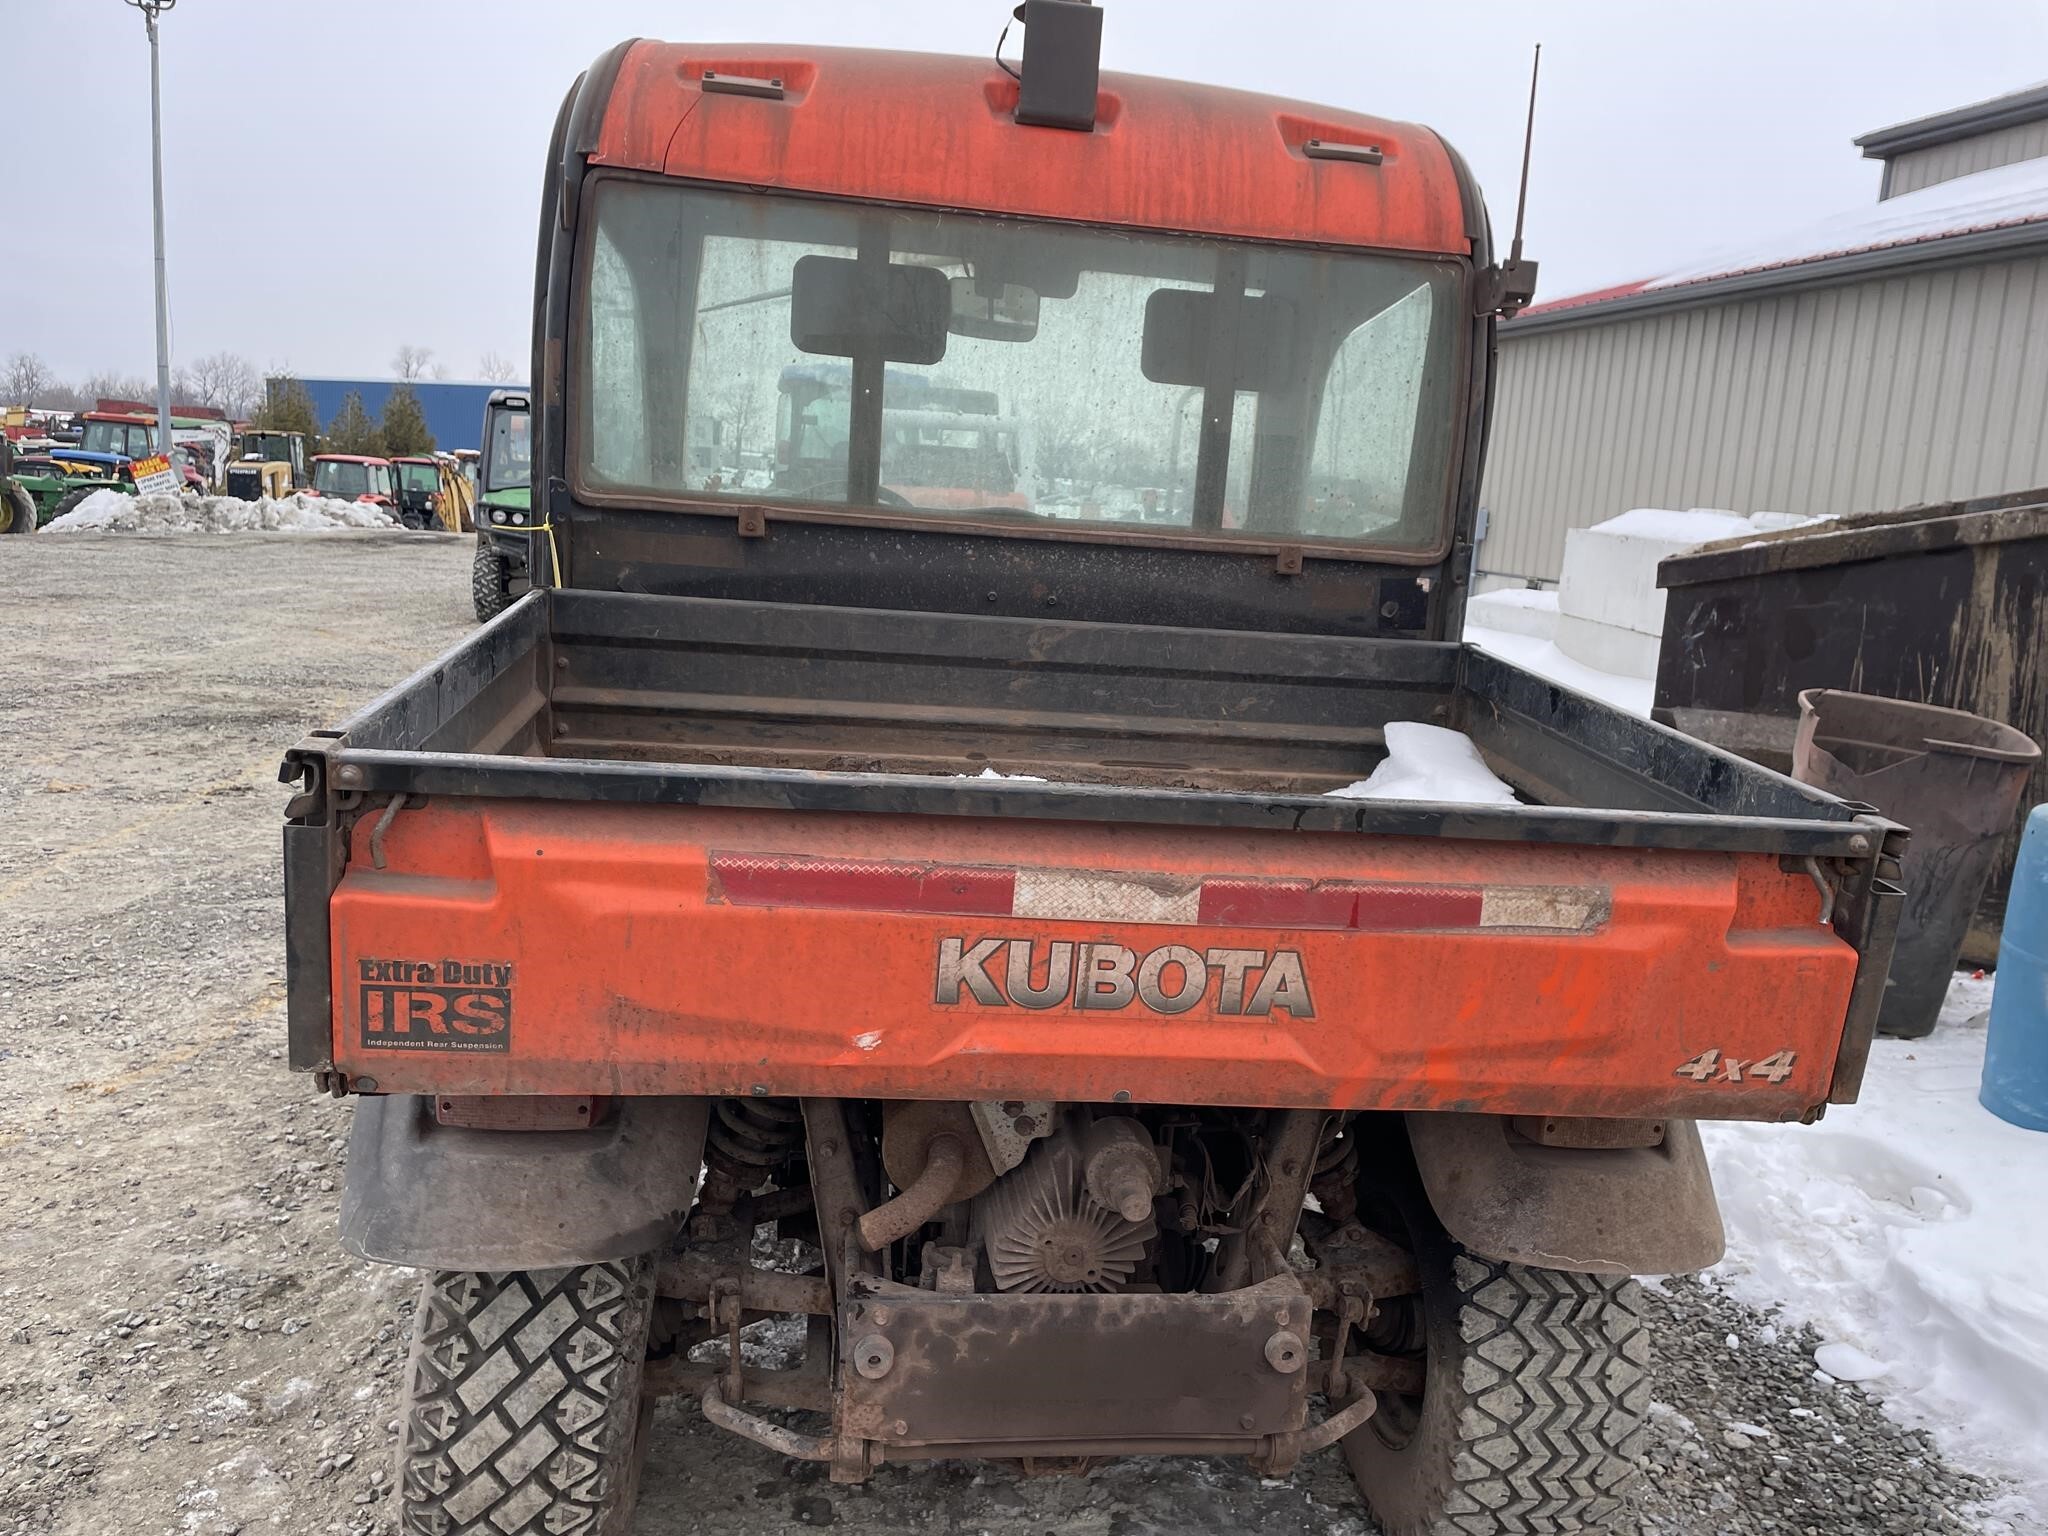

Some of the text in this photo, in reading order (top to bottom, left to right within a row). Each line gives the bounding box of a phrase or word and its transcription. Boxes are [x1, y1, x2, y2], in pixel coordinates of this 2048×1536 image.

[360, 959, 512, 987] Extra Duty
[936, 937, 1316, 1018] KUBOTA
[367, 990, 506, 1035] IRS
[367, 1039, 425, 1048] Independent
[451, 1041, 504, 1049] Suspension
[1674, 1048, 1797, 1083] 4x4
